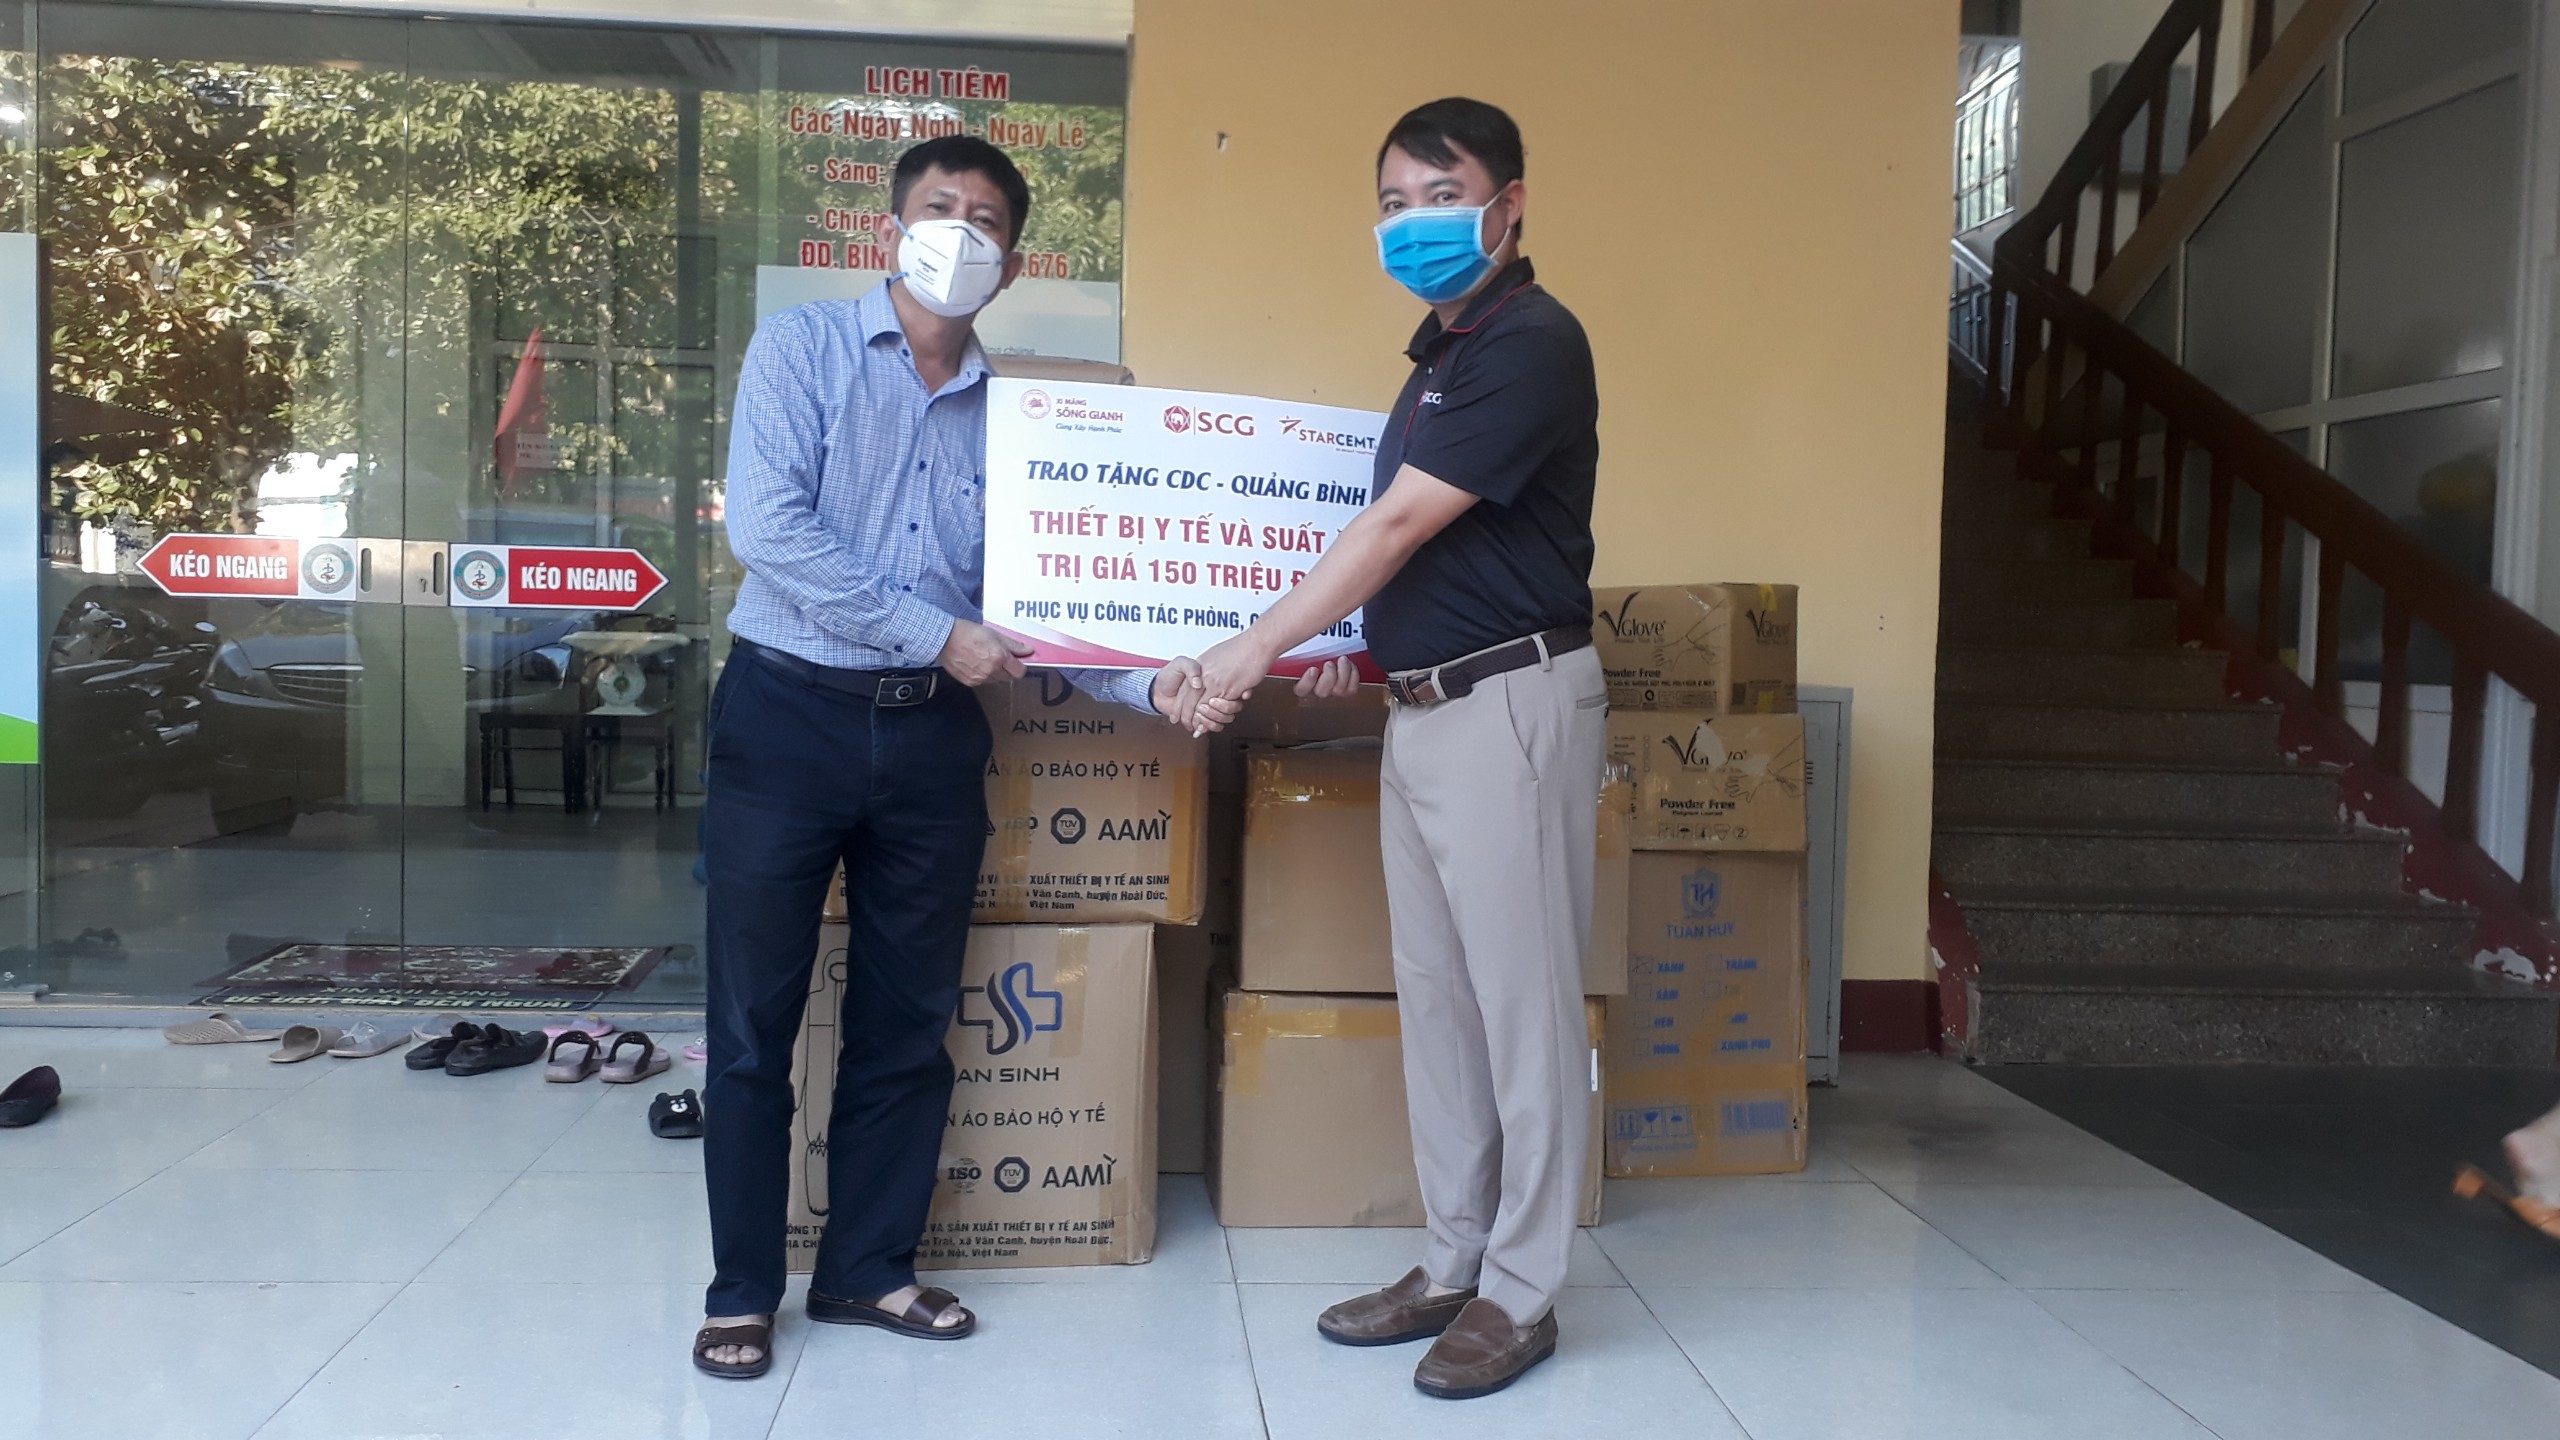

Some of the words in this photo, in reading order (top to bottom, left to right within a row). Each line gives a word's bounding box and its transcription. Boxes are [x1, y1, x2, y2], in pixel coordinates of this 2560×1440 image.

[865, 66, 931, 99] LỊCH
[938, 65, 1010, 100] TIÊM
[789, 105, 834, 135] Các
[1056, 407, 1086, 419] SÔNG
[1089, 410, 1123, 421] GIANH
[1197, 411, 1255, 436] SCG
[1299, 429, 1375, 449] STARCEMT
[1027, 460, 1088, 482] TRAO
[1097, 461, 1159, 488] TẶNG
[1166, 469, 1211, 491] CDC
[1231, 472, 1310, 500] QUẢNG
[1316, 481, 1367, 507] BÌNH
[1029, 505, 1108, 537] THIẾT
[1119, 515, 1144, 545] BỊ
[1154, 517, 1170, 541] Y
[1179, 513, 1214, 544] TẾ
[1220, 518, 1253, 547] VÀ
[1262, 522, 1325, 554] SUẤT
[170, 549, 210, 578] KÉO
[216, 555, 288, 580] NGANG
[521, 561, 561, 590] KÉO
[567, 567, 637, 592] NGANG
[1037, 553, 1081, 584] TRỊ
[1092, 552, 1137, 581] GIÁ
[1148, 559, 1197, 584] 150
[1207, 561, 1281, 595] TRIỆU
[1014, 600, 1061, 622] PHỤC
[1067, 602, 1088, 623] VỤ
[1094, 600, 1141, 622] CÔNG
[1147, 603, 1178, 624] TÁC
[1183, 606, 1244, 631] PHÒNG,
[1012, 719, 1047, 734] AN
[1054, 719, 1114, 734] SINH
[1050, 760, 1087, 777] BẢO
[1093, 760, 1118, 780] HỘ
[1124, 763, 1135, 777] Y
[1140, 757, 1160, 777] TẾ
[1660, 798, 1704, 809] Powder
[1709, 798, 1736, 809] Free
[1060, 873, 1087, 885] THIẾT
[1105, 875, 1110, 885] Y
[1113, 873, 1127, 885] TẾ
[1129, 875, 1143, 885] AN
[1146, 875, 1170, 885] SINH
[1052, 902, 1075, 910] Nam
[956, 1068, 991, 1083] AN
[999, 1067, 1060, 1082] SINH
[961, 1109, 988, 1127] ÁO
[994, 1107, 1032, 1126] BẢO
[1038, 1107, 1063, 1128] HỘ
[1069, 1110, 1080, 1123] Y
[1085, 1102, 1105, 1122] TẾ
[947, 1166, 982, 1180] ISO
[1004, 1219, 1031, 1231] THIẾT
[1034, 1221, 1045, 1233] BỊ
[1049, 1221, 1055, 1231] Y
[1058, 1219, 1071, 1231] TẾ
[1073, 1221, 1087, 1231] AN
[1091, 1219, 1115, 1230] SINH
